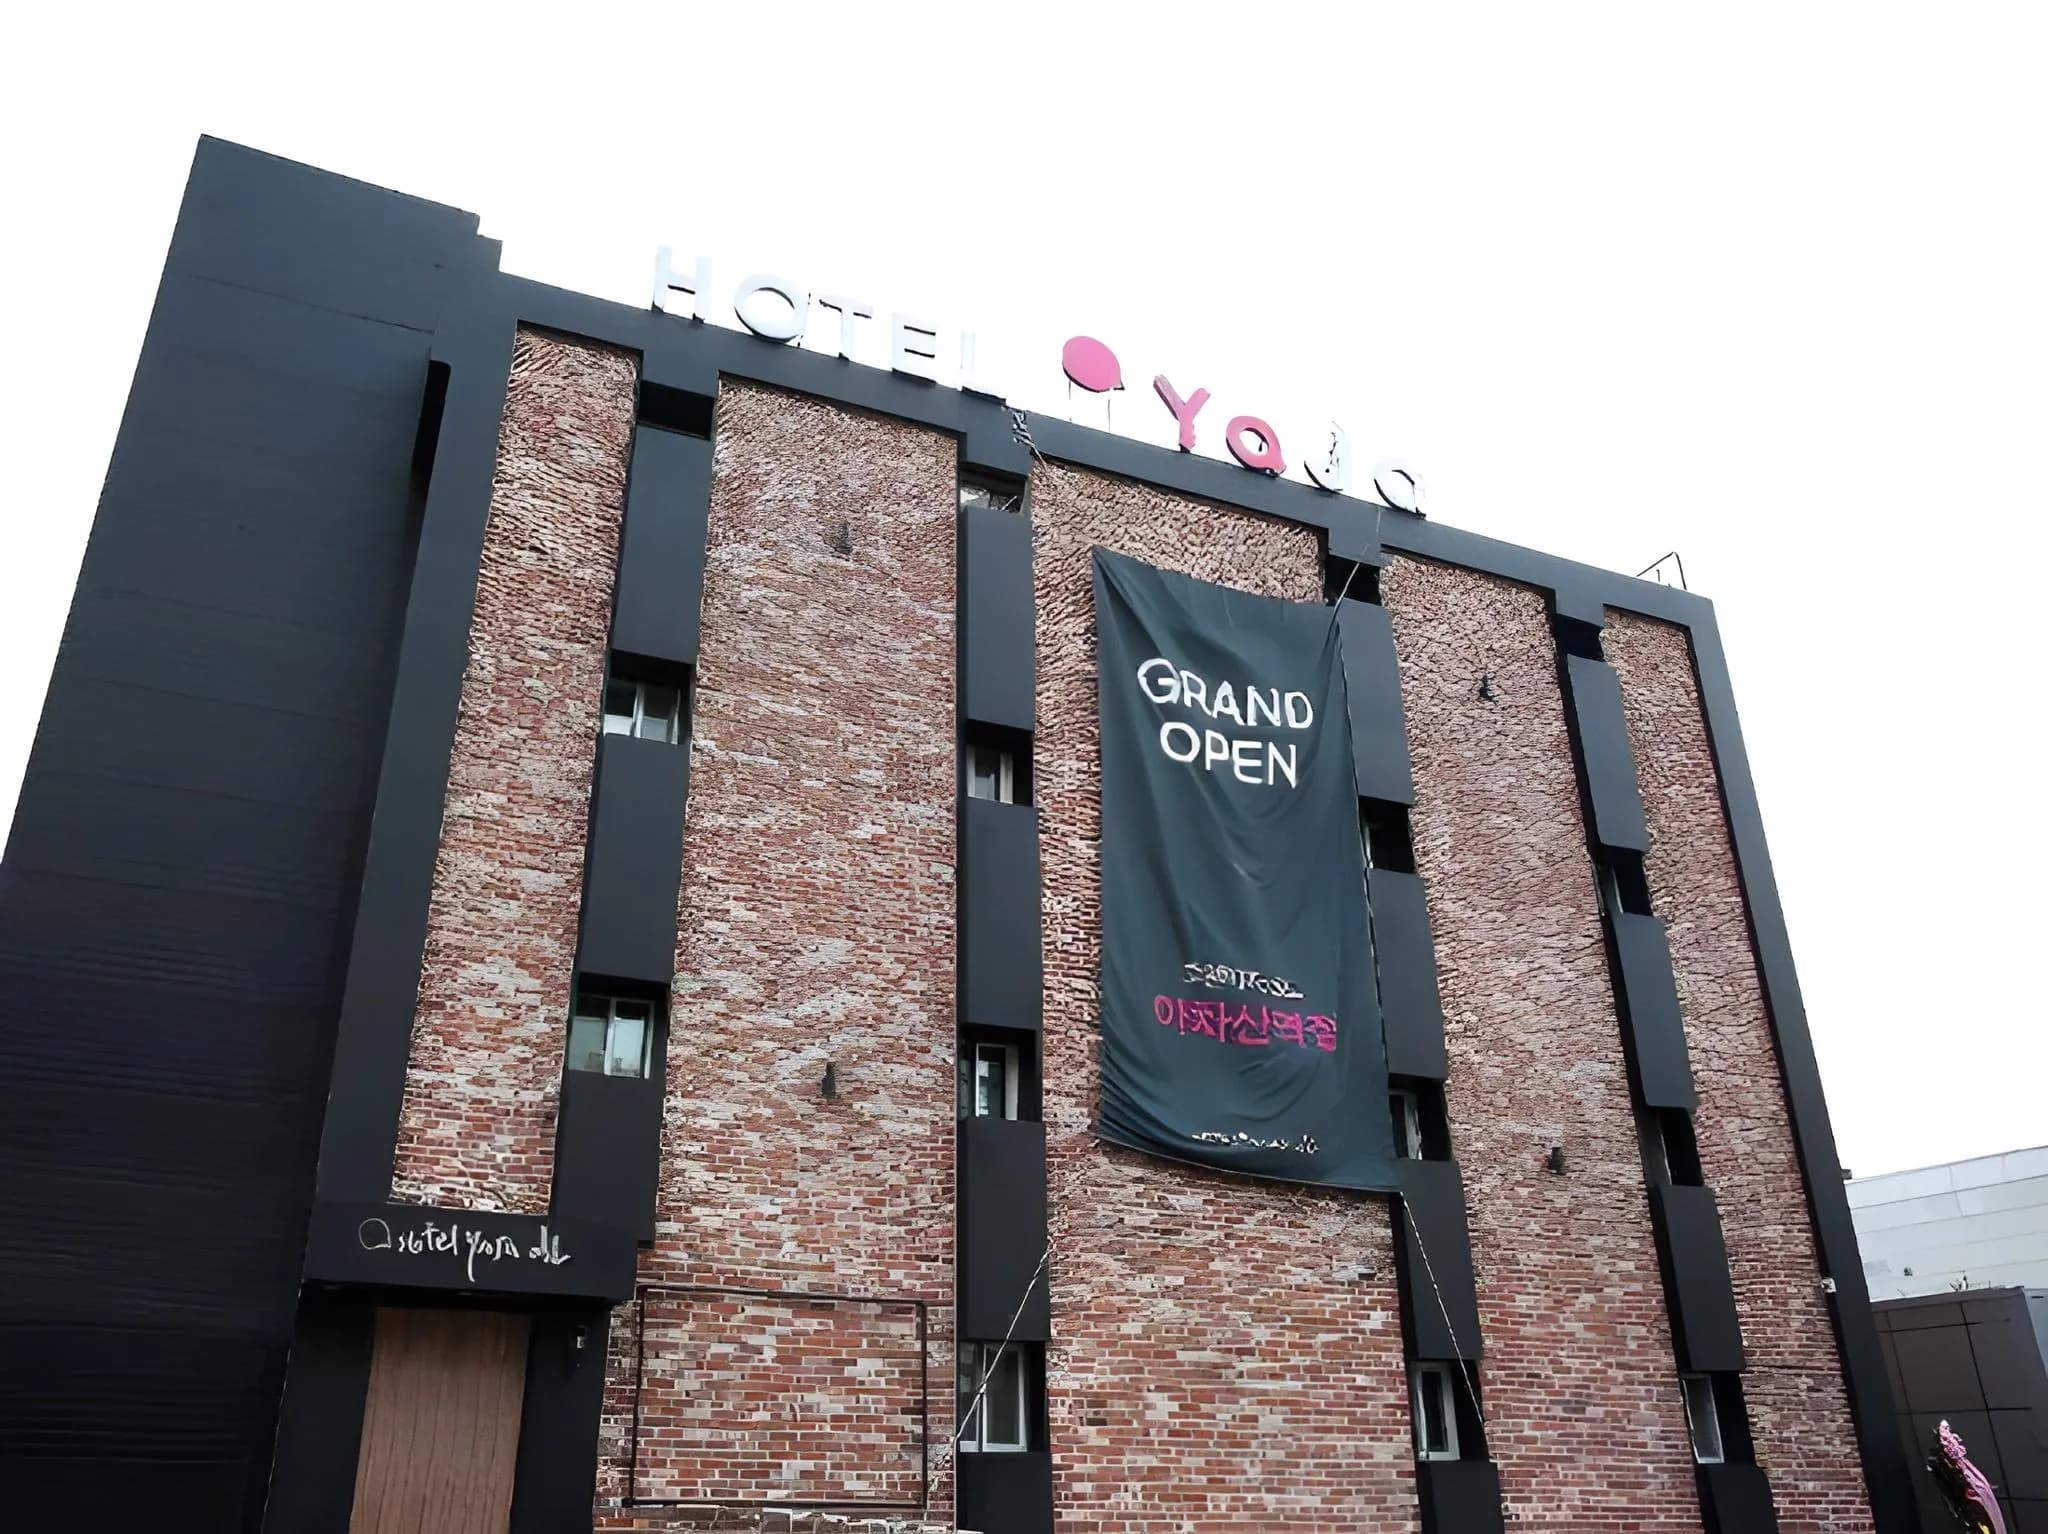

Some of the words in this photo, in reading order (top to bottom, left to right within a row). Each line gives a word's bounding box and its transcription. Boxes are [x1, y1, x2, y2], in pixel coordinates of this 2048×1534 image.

[652, 245, 1007, 400] HOTEL
[1137, 658, 1314, 729] GRAND
[1160, 721, 1297, 789] OPEN
